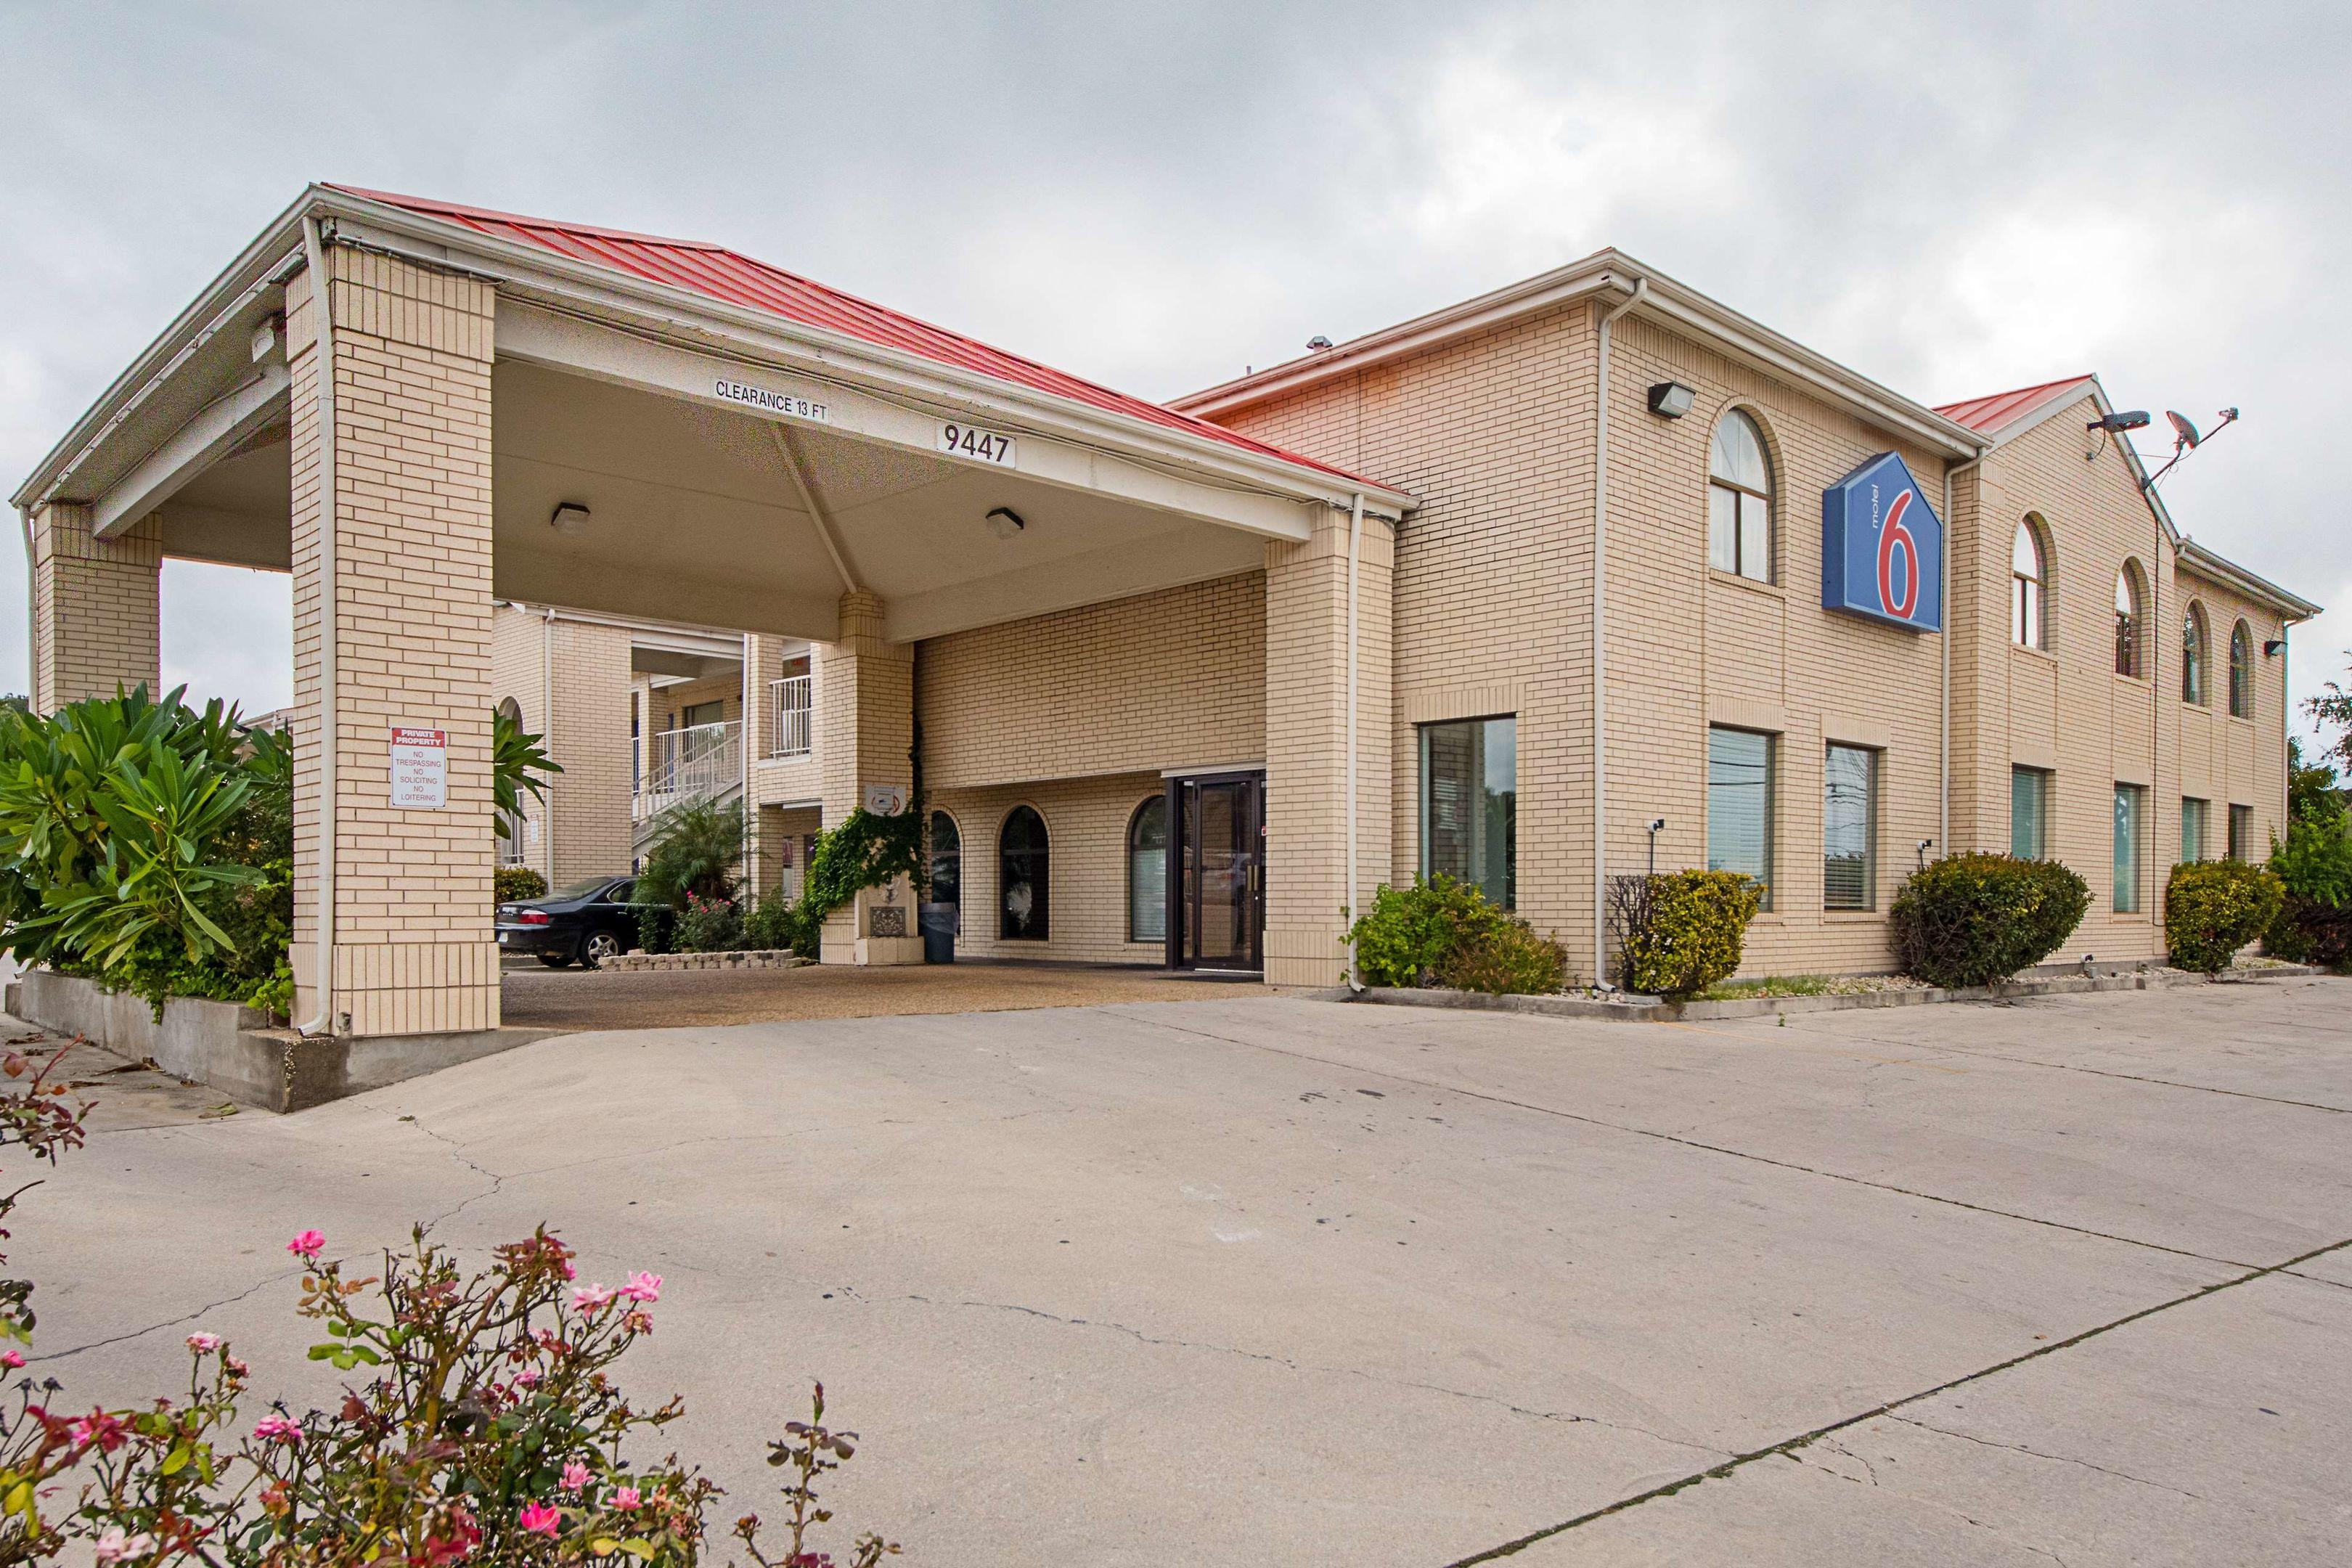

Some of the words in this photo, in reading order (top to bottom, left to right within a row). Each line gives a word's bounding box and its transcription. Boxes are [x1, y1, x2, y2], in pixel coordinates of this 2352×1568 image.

[716, 381, 792, 412] CLEARANCE
[797, 401, 808, 416] 13
[812, 404, 827, 420] FT
[944, 425, 1009, 462] 9447
[1877, 489, 1919, 620] 6
[396, 737, 441, 746] PROPERTY
[401, 729, 435, 738] PRIVATE
[396, 759, 441, 767] TRESPASSING
